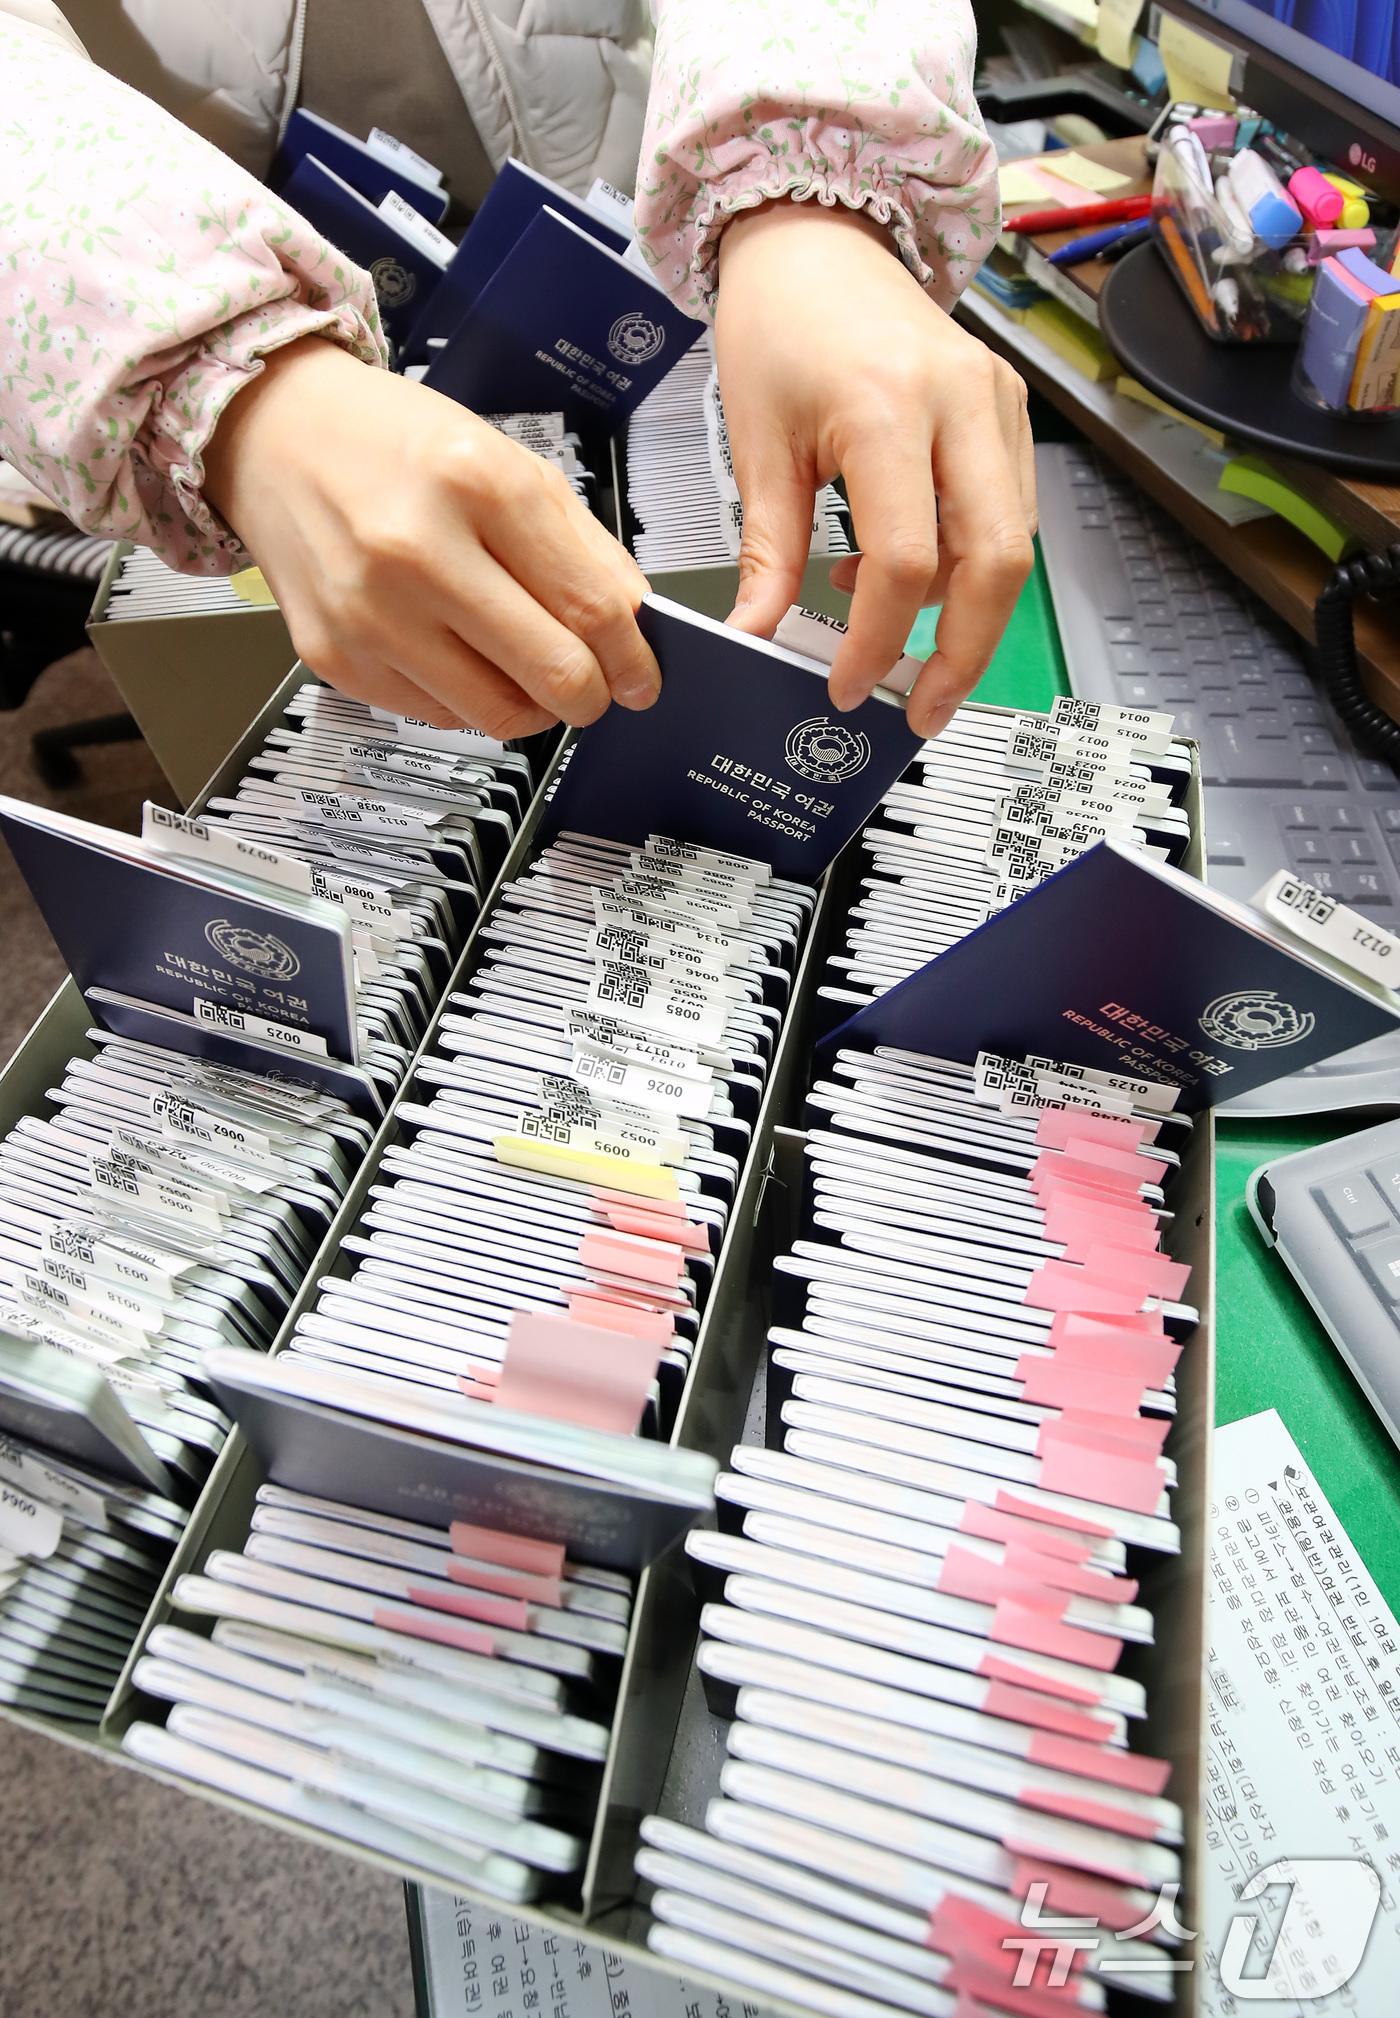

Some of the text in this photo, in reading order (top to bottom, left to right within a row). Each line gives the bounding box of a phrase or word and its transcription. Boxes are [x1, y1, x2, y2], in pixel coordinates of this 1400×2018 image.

[1361, 152, 1376, 173] LG
[535, 350, 576, 378] REPUBLIC
[554, 338, 607, 375] 대한민국
[606, 370, 632, 391] 여권
[1119, 711, 1150, 724] 0014
[1077, 735, 1109, 748] 0017
[1116, 728, 1148, 741] 0015
[1076, 749, 1107, 760] 0019
[1074, 760, 1106, 772] 0023
[710, 754, 835, 819] 대한민국 여권
[1114, 778, 1146, 790] 0024
[686, 769, 817, 834] REPUBLIC OF KOREA
[1081, 799, 1113, 813] 0034
[1112, 791, 1145, 803] 0027
[357, 801, 386, 813] 0038
[378, 816, 408, 827] 0115
[747, 810, 812, 842] PASSPORT
[236, 842, 278, 866] 0079
[717, 859, 749, 870] 0084
[344, 885, 375, 900] 0080
[362, 902, 391, 917] 0143
[686, 900, 718, 913] 0098
[696, 931, 729, 947] 0134
[1352, 928, 1392, 957] 0121
[668, 948, 702, 964] 0034
[164, 952, 257, 994] 대한민국
[263, 988, 308, 1012] 여권
[685, 968, 719, 984] 0046
[155, 964, 228, 996] REPUBLIC
[232, 992, 253, 1006] OF
[257, 1000, 310, 1025] KOREA
[666, 1004, 701, 1021] 0085
[266, 1027, 301, 1045] 0025
[1098, 1001, 1235, 1077] 대한민국 여권
[636, 1042, 670, 1058] 0173
[1062, 1009, 1200, 1086] REPUBLIC OF KOREA
[646, 1079, 683, 1098] 0026
[1107, 1077, 1149, 1094] 0125
[213, 1123, 245, 1143] 0062
[620, 1129, 656, 1147] 0052
[594, 1140, 631, 1158] 0095
[159, 1195, 194, 1213] 0065
[1343, 1187, 1358, 1204] Ctrl
[114, 1263, 149, 1282] 0031
[106, 1290, 141, 1313] 0018
[1342, 1615, 1366, 1646] 반납
[1366, 1655, 1379, 1671] 후
[1317, 1667, 1341, 1701] 여권
[1338, 1712, 1385, 1784] 찾아오기
